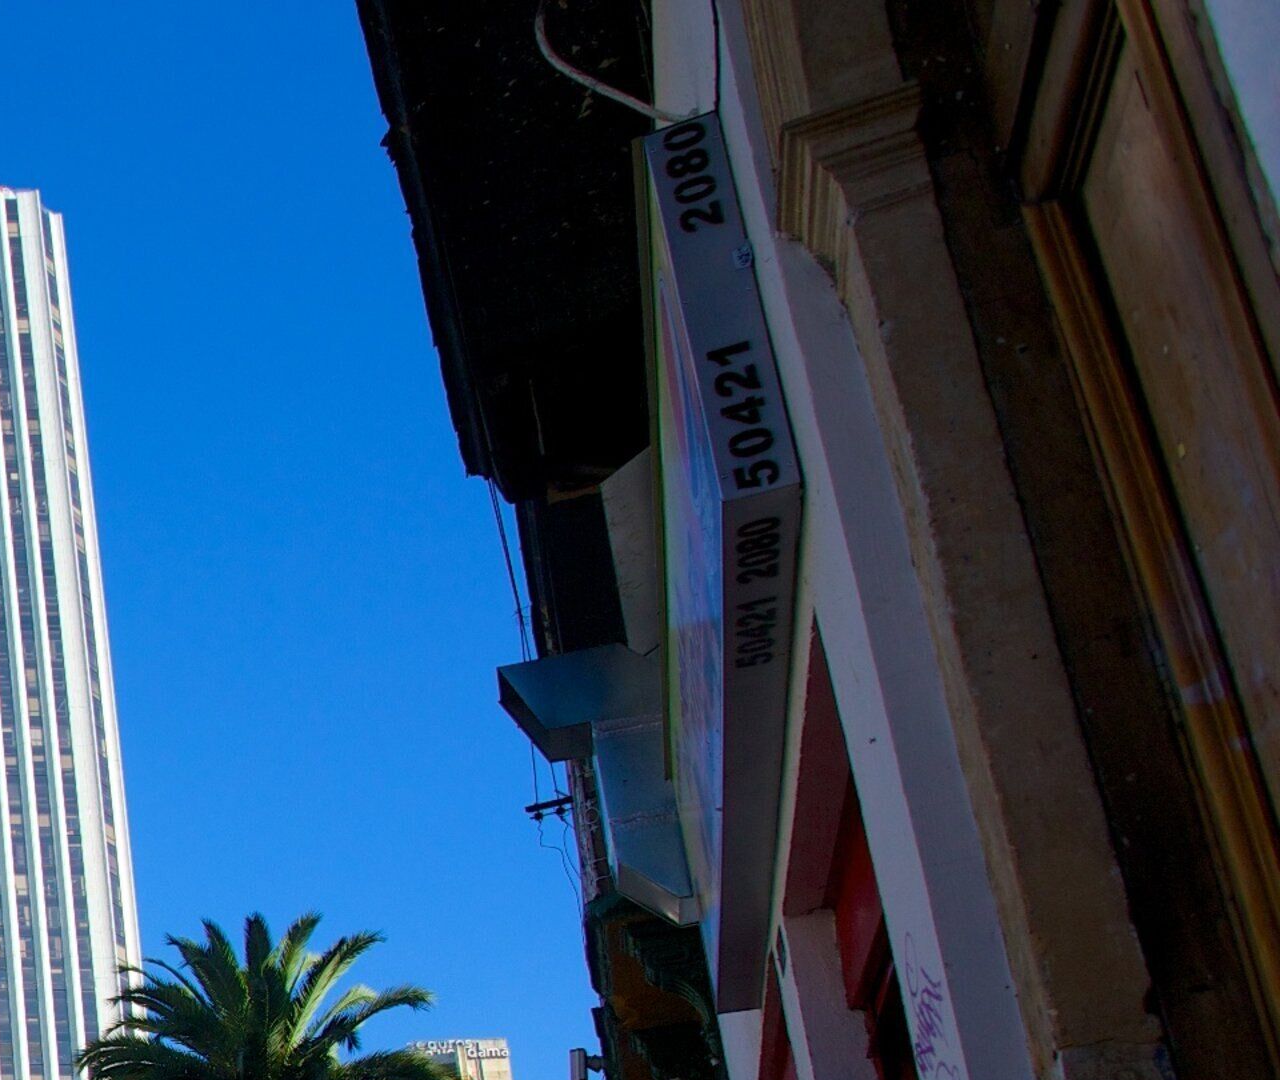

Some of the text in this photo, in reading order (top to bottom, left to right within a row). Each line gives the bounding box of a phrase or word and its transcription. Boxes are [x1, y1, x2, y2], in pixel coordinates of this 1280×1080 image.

[663, 121, 780, 490] 50421 2080
[734, 516, 781, 669] 50421 2080
